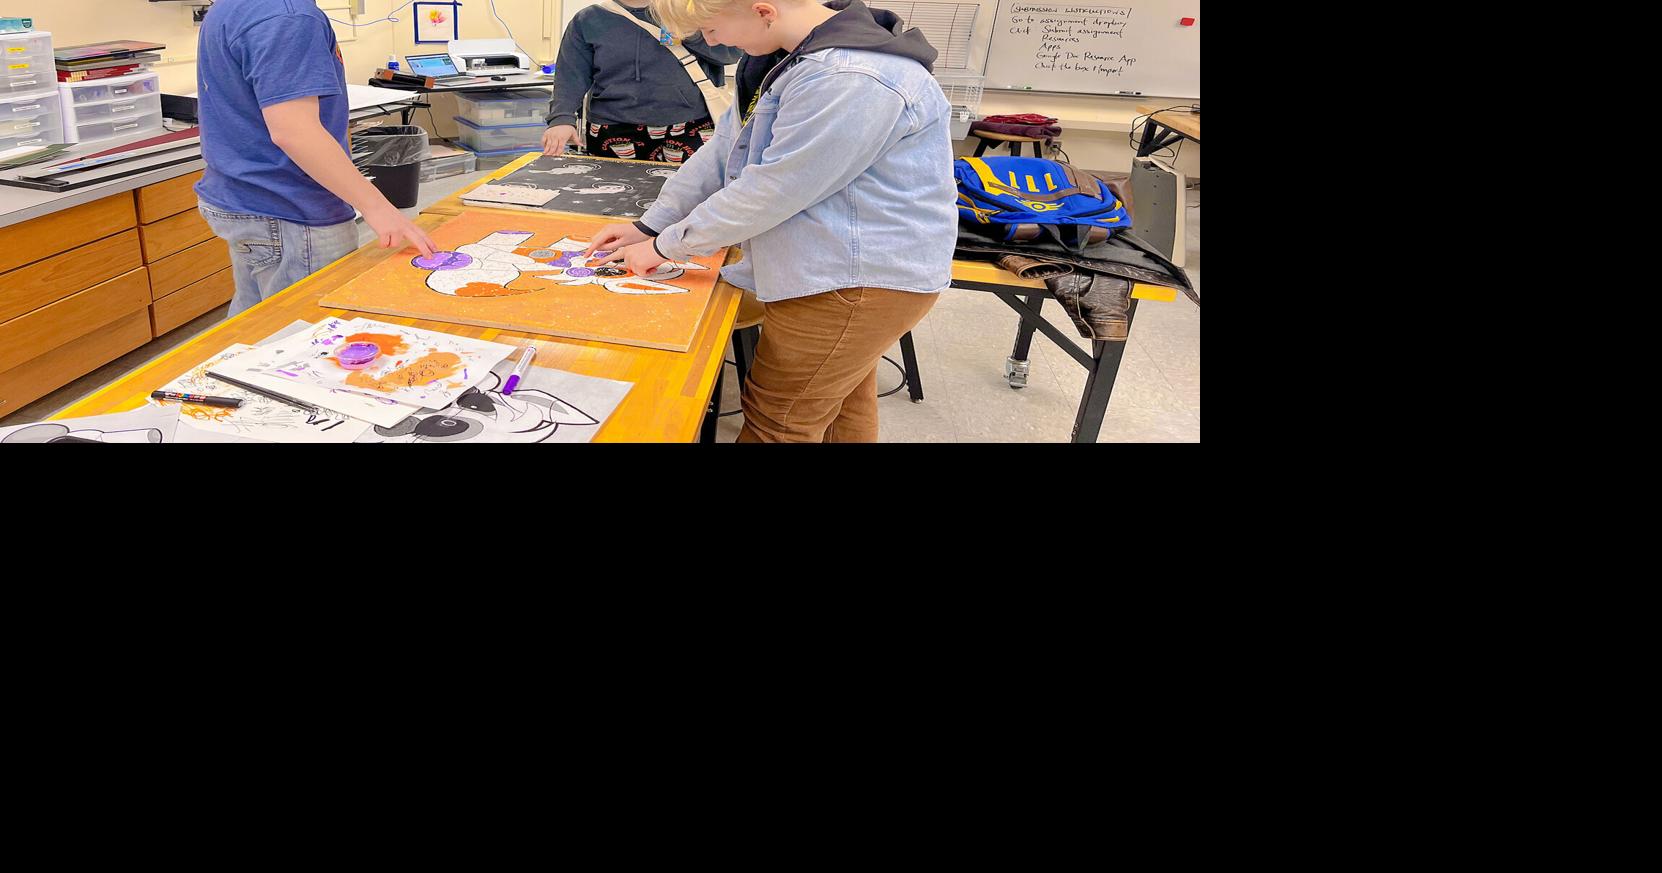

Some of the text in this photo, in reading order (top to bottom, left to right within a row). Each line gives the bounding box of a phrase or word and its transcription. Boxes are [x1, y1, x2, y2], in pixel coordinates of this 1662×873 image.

[1038, 42, 1061, 52] Apps
[1118, 54, 1137, 66] App
[601, 137, 631, 151] CAUTION
